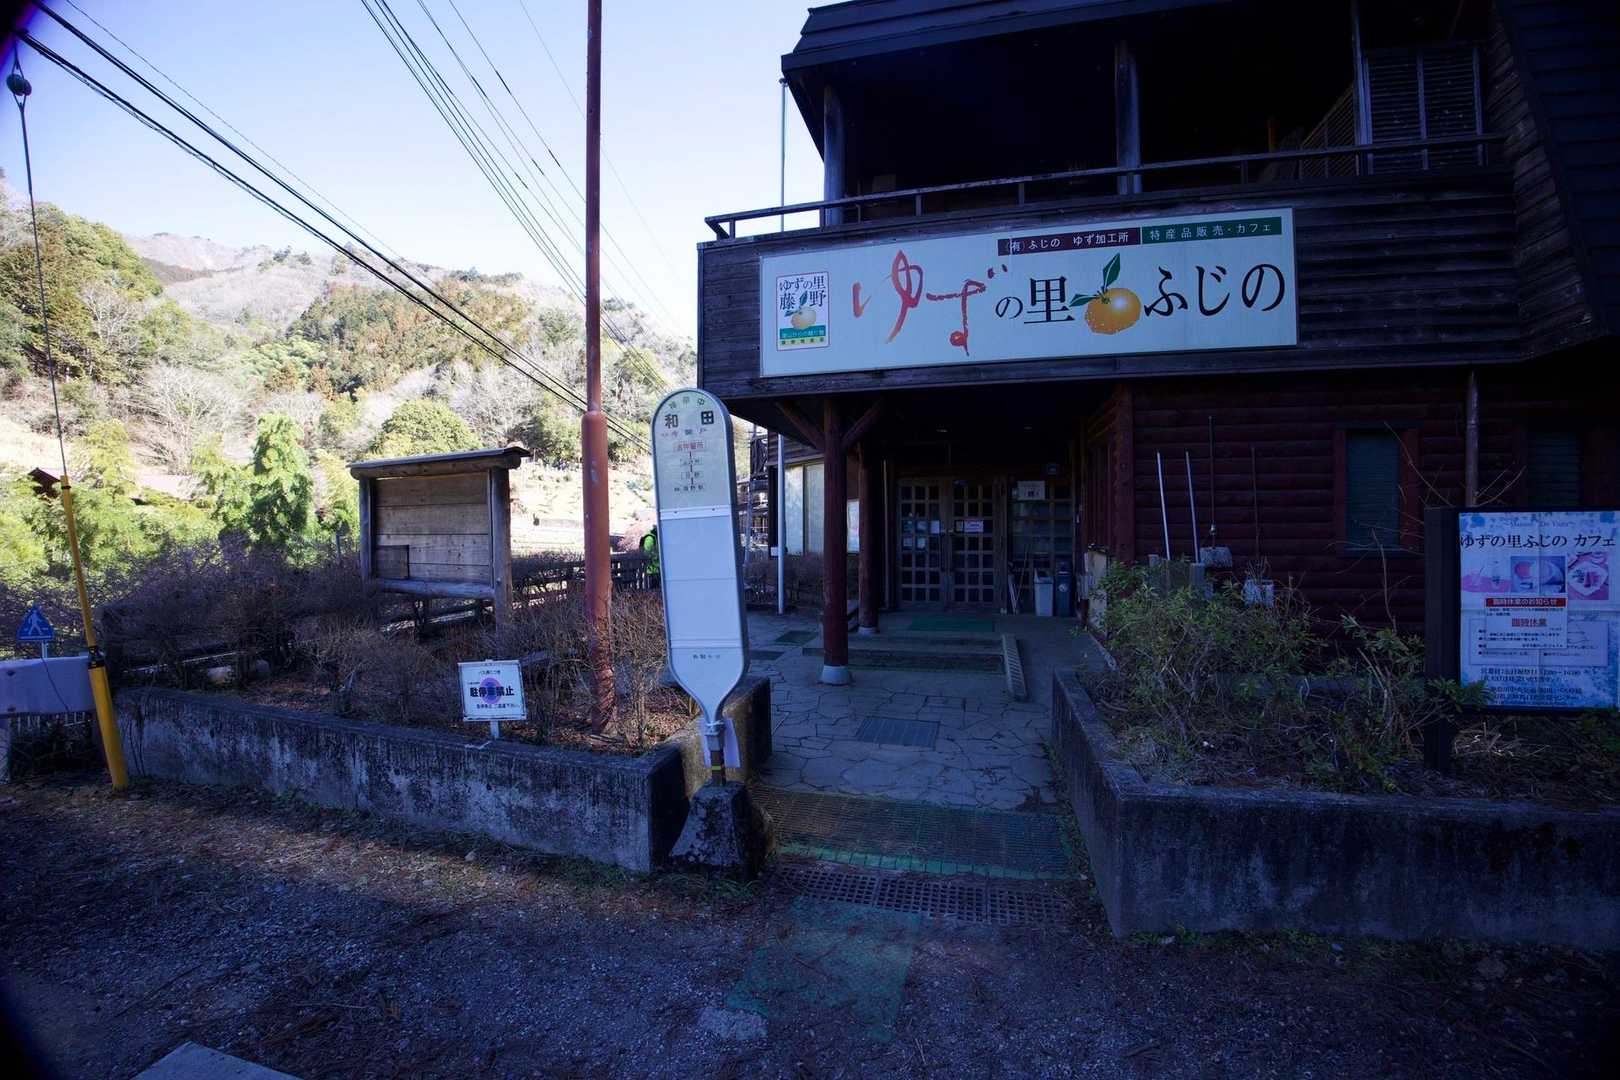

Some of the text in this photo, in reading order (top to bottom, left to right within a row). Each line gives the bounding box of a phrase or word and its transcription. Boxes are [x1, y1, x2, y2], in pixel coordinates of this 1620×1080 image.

[1072, 231, 1130, 247] ゆず加工所
[1149, 223, 1272, 242] 特産品販売・カフェ
[779, 275, 827, 292] ゆずの里
[1143, 263, 1287, 318] ふじの
[664, 410, 715, 429] 和田
[1460, 533, 1616, 548] ゆずの里ふじの カフェ
